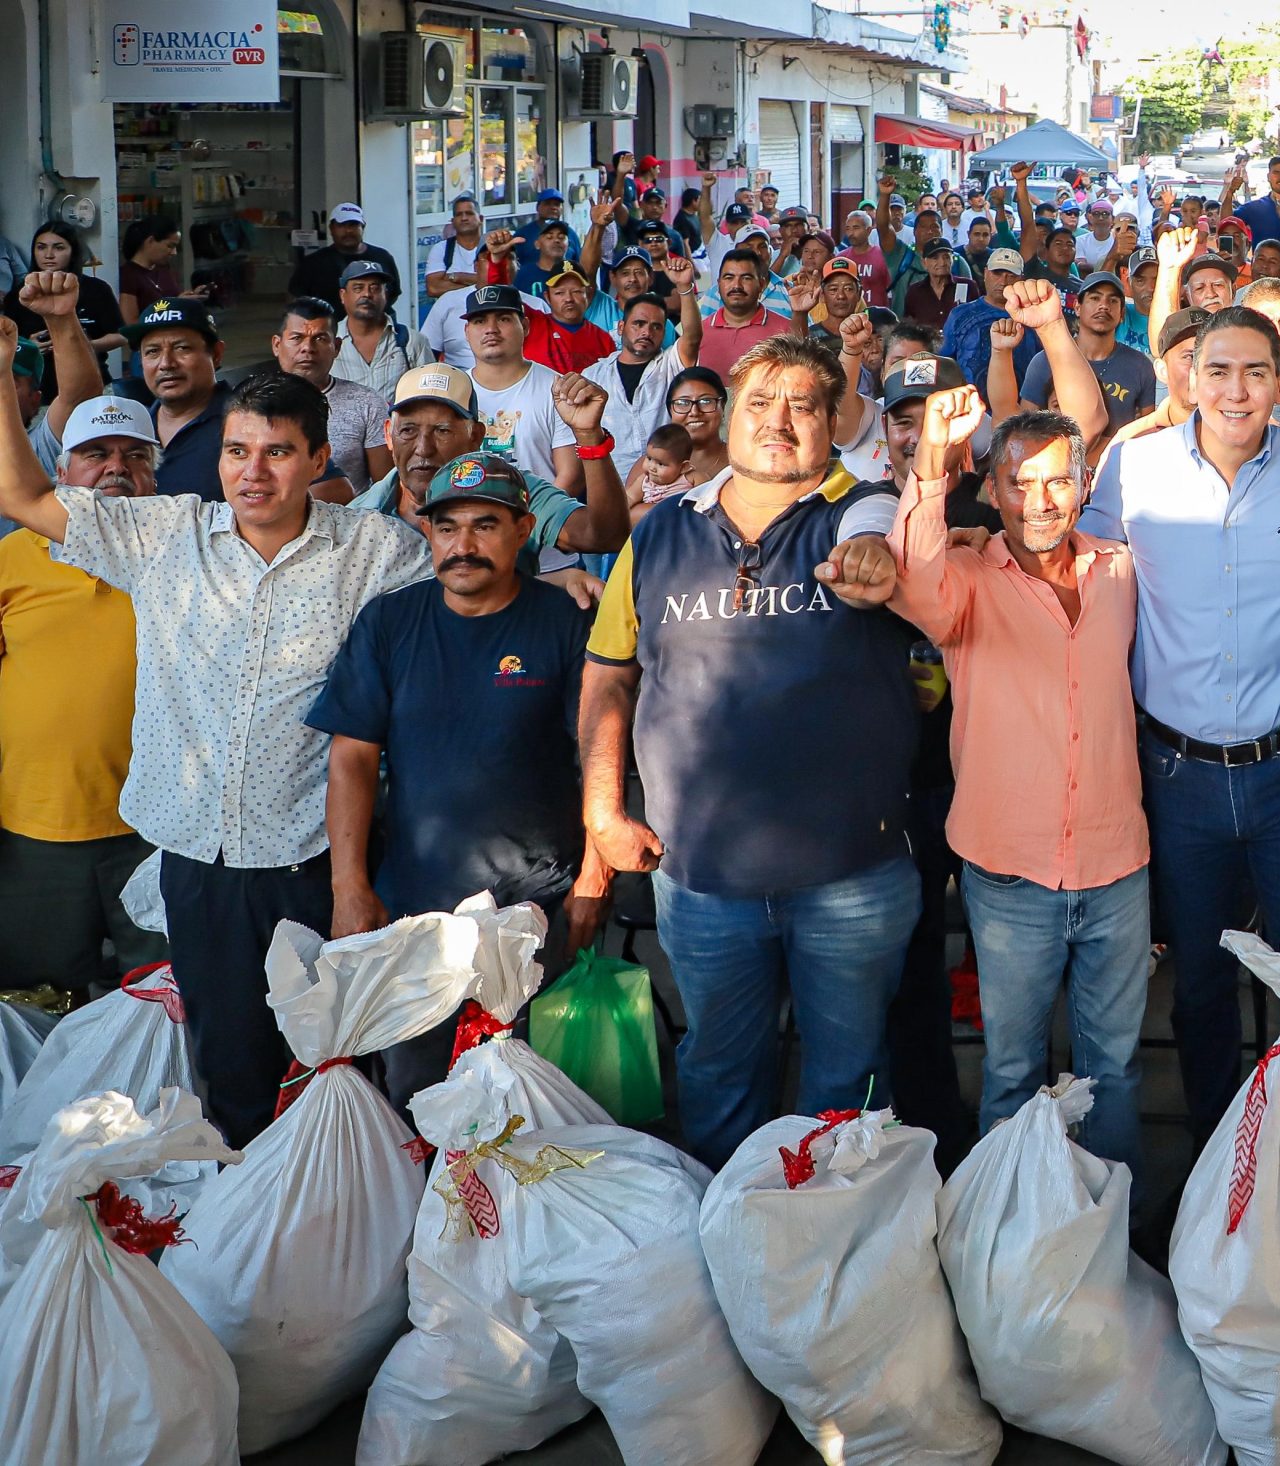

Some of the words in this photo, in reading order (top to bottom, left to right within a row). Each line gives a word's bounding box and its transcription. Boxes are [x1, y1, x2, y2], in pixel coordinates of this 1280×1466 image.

[142, 31, 251, 49] FARMACIA
[143, 49, 227, 61] PHARMACY
[234, 50, 263, 63] PVR
[143, 309, 183, 324] KMR
[90, 412, 134, 425] PATRÓN
[660, 582, 833, 625] NAUTICA
